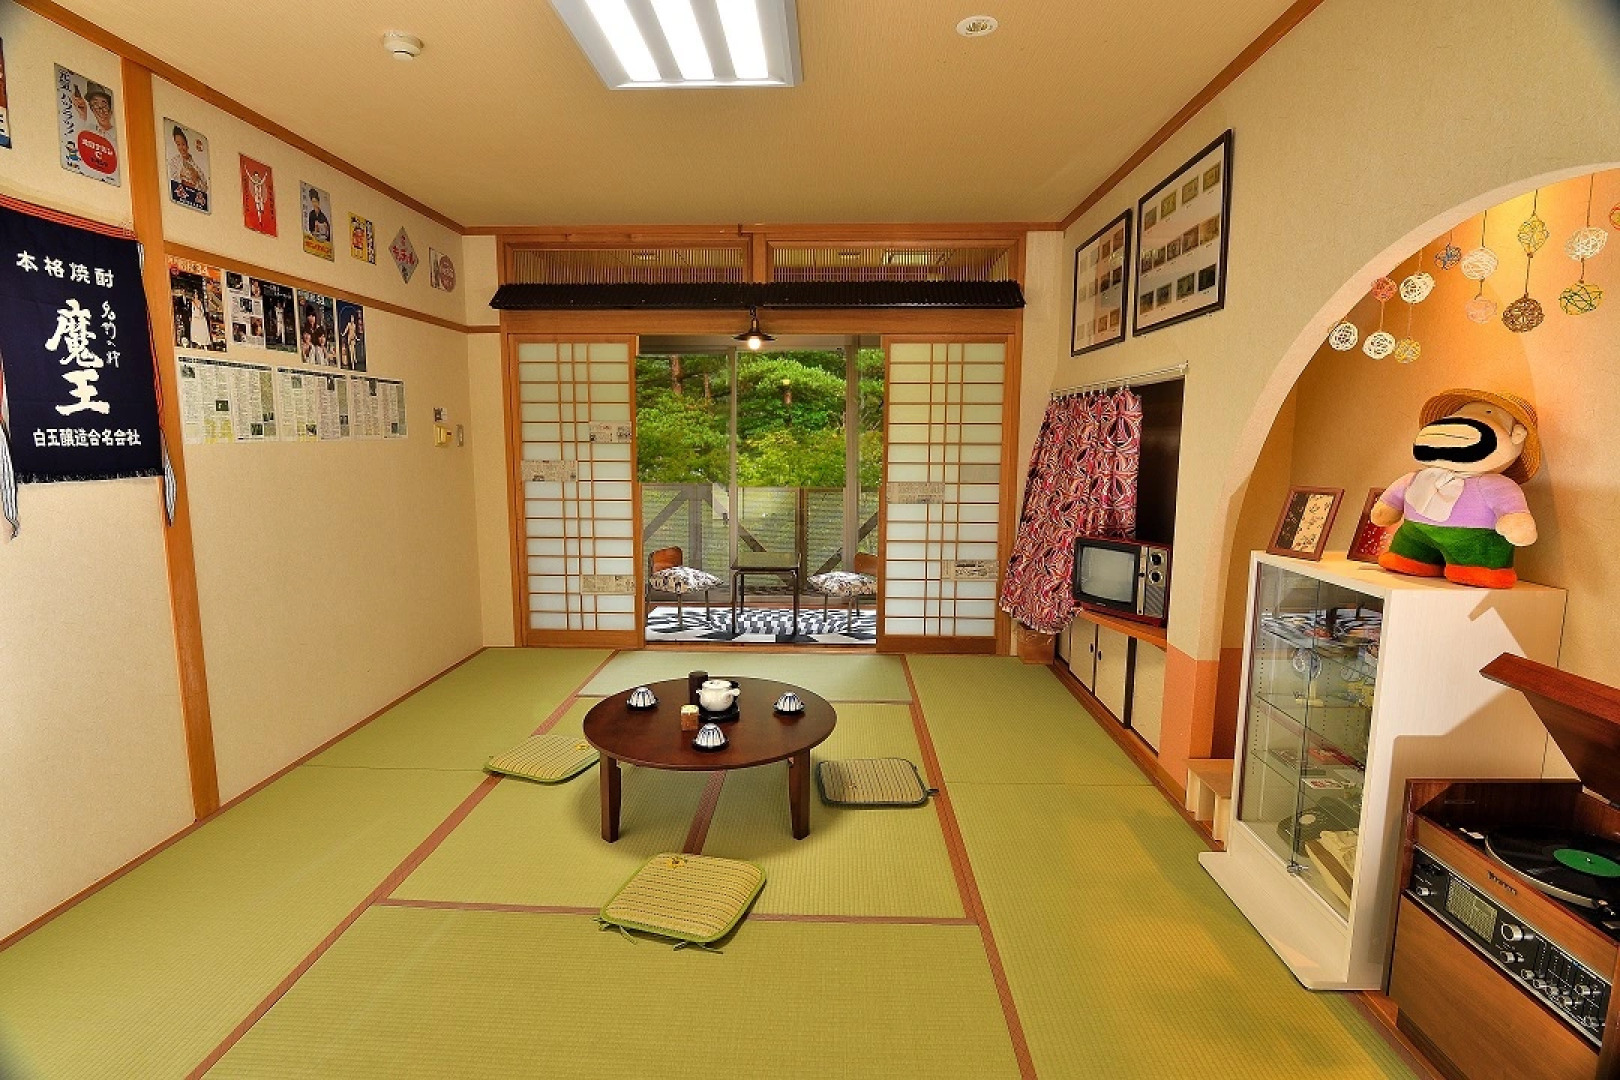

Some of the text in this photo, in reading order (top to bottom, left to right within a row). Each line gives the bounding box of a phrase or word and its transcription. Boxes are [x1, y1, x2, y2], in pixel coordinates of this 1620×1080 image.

[17, 250, 114, 288] 本格焼酎
[45, 298, 110, 415] 魔王
